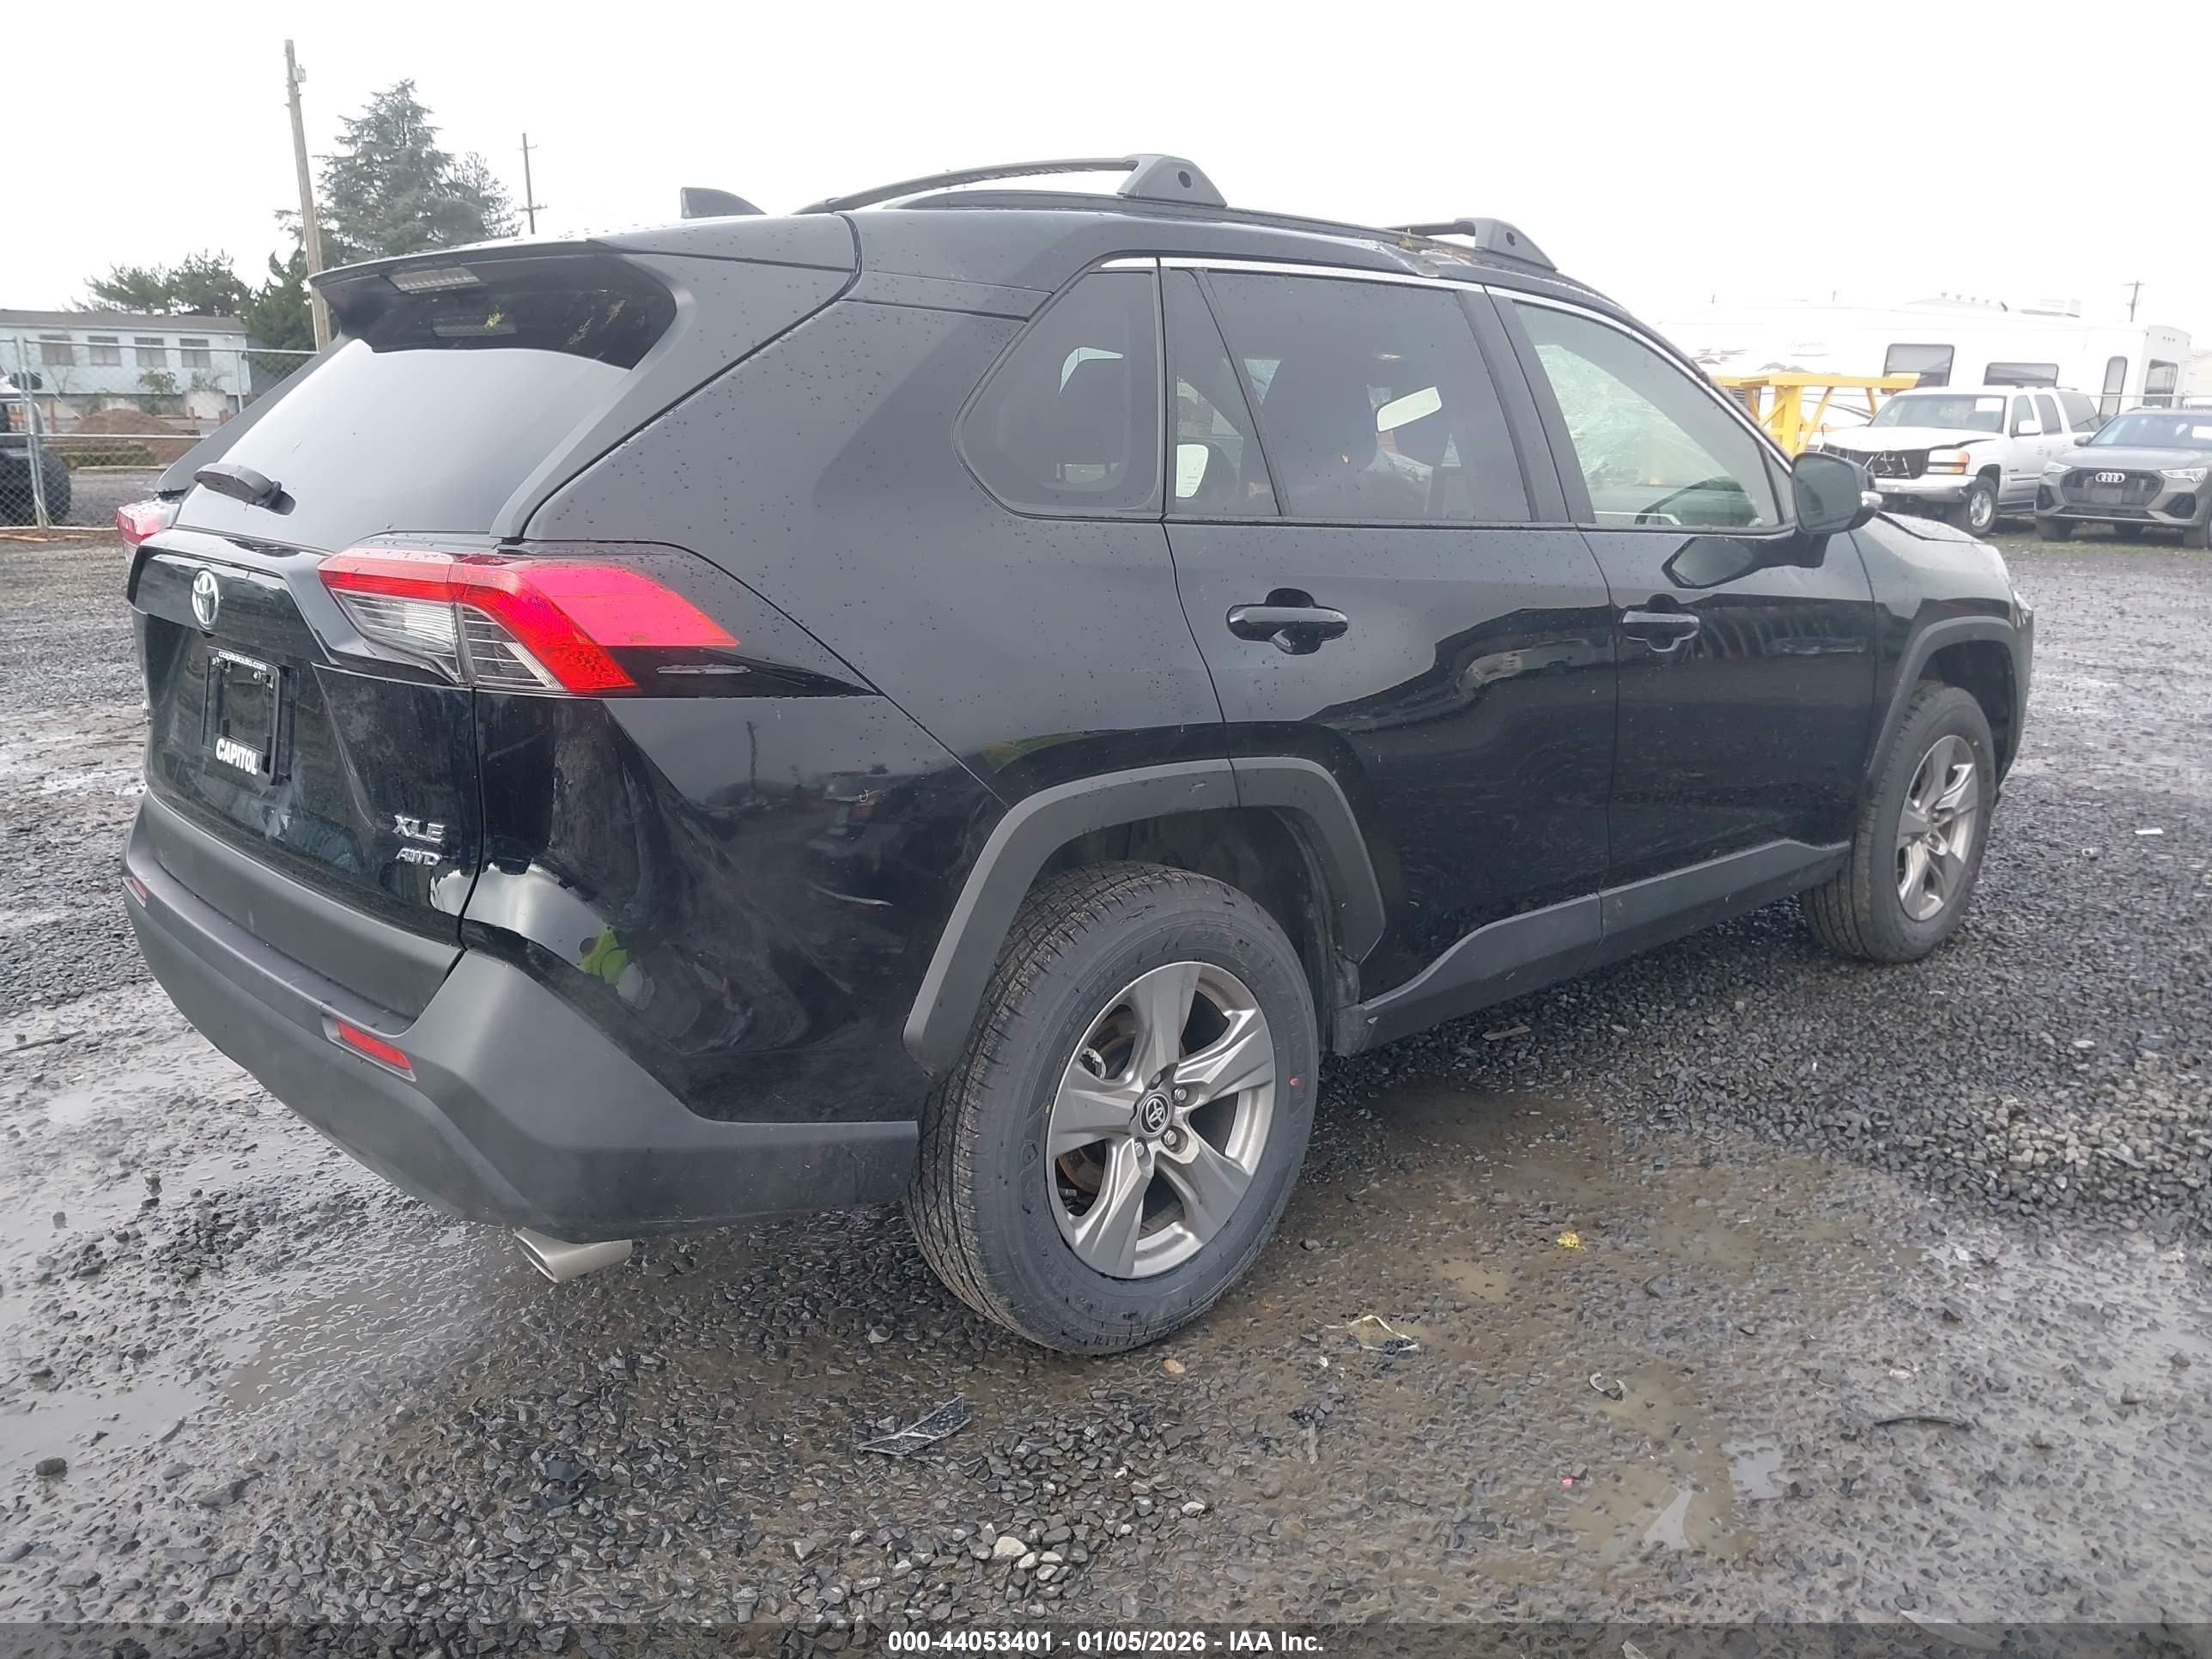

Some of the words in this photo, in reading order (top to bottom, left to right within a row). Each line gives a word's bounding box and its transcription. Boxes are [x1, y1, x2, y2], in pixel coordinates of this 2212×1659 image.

[216, 738, 258, 775] CAPITOL
[392, 815, 447, 844] XLE
[395, 848, 442, 866] AWD
